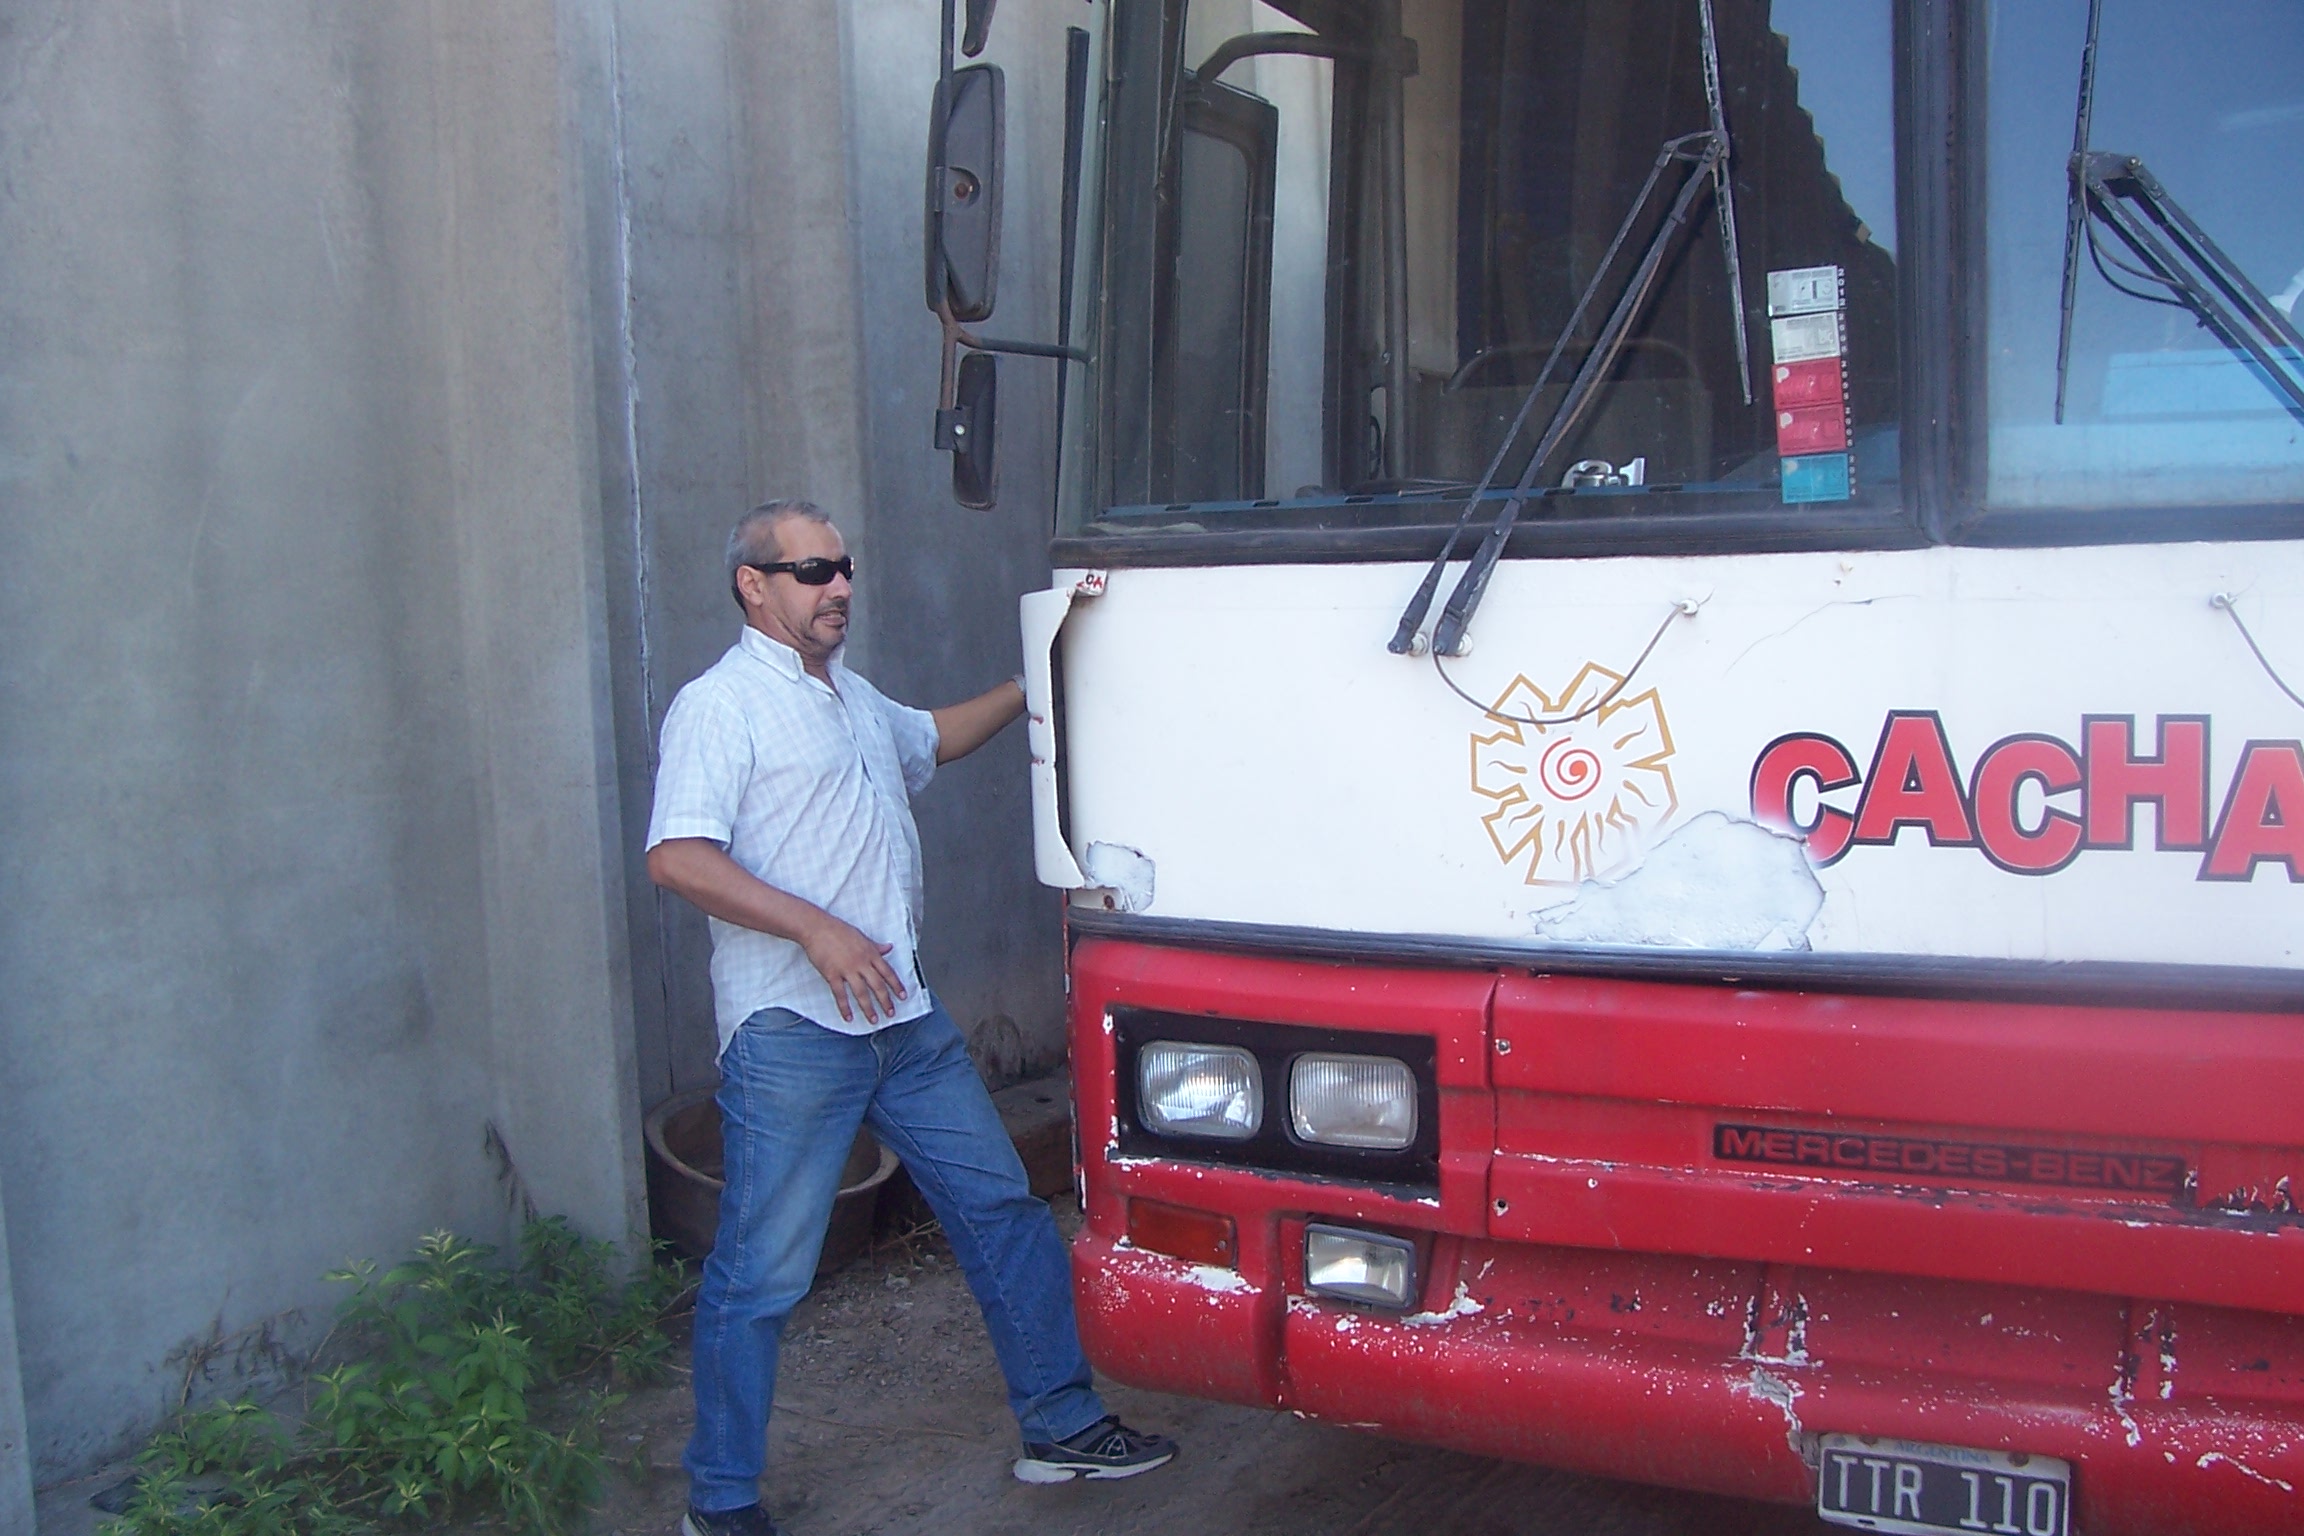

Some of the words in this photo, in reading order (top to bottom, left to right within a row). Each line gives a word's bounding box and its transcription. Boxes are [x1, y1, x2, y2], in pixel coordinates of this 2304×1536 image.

[1838, 268, 1846, 307] 2012
[1749, 709, 2304, 884] CACHA
[1721, 1128, 2179, 1188] MERCEDES-BENZ
[1832, 1454, 1923, 1519] TTR
[1960, 1471, 2057, 1536] 110
